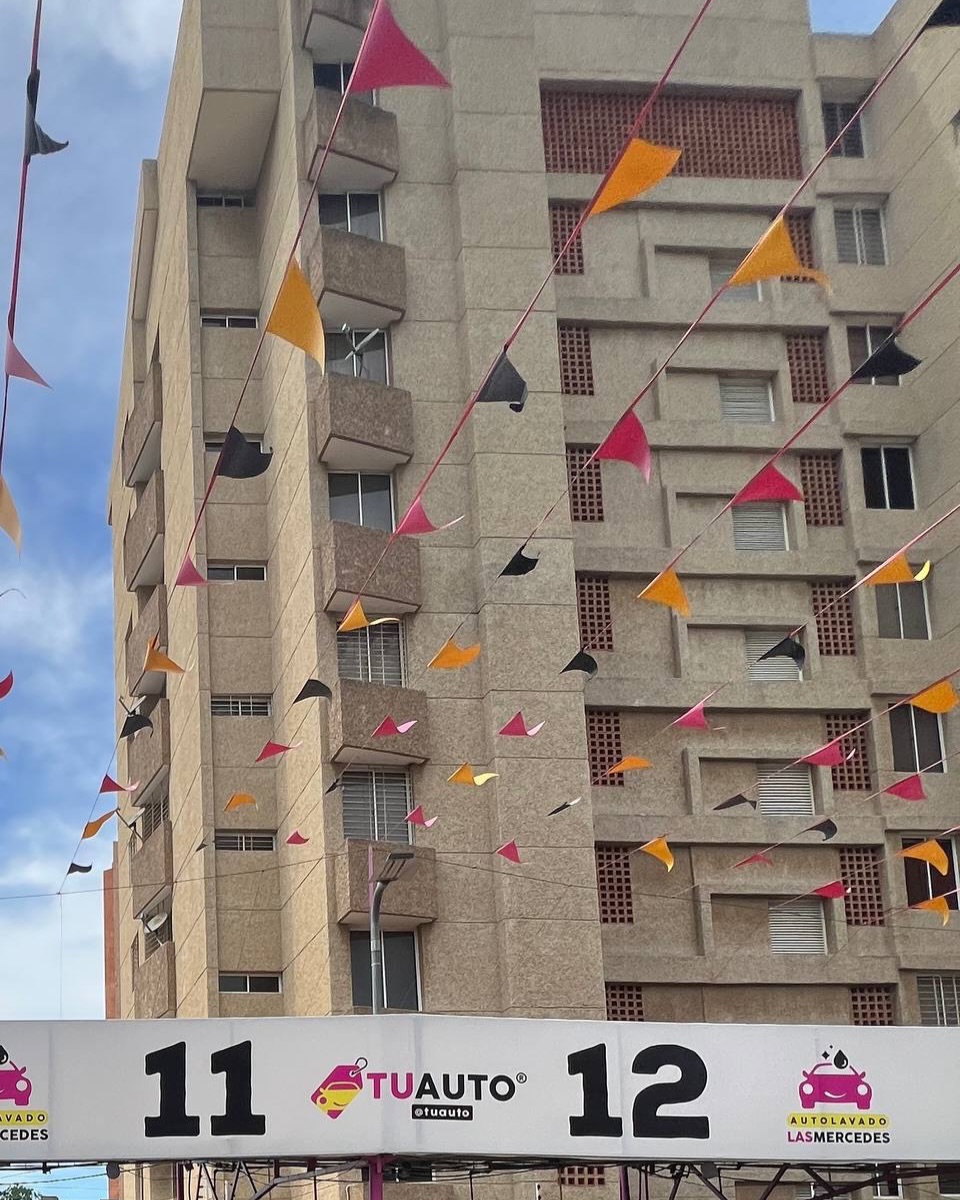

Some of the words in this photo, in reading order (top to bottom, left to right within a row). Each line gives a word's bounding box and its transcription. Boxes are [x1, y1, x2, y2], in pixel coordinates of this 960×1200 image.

[144, 1040, 266, 1137] 11
[414, 1106, 470, 1119] @tuauto
[567, 1043, 709, 1139] 12
[790, 1116, 887, 1126] AUTOLAVADO
